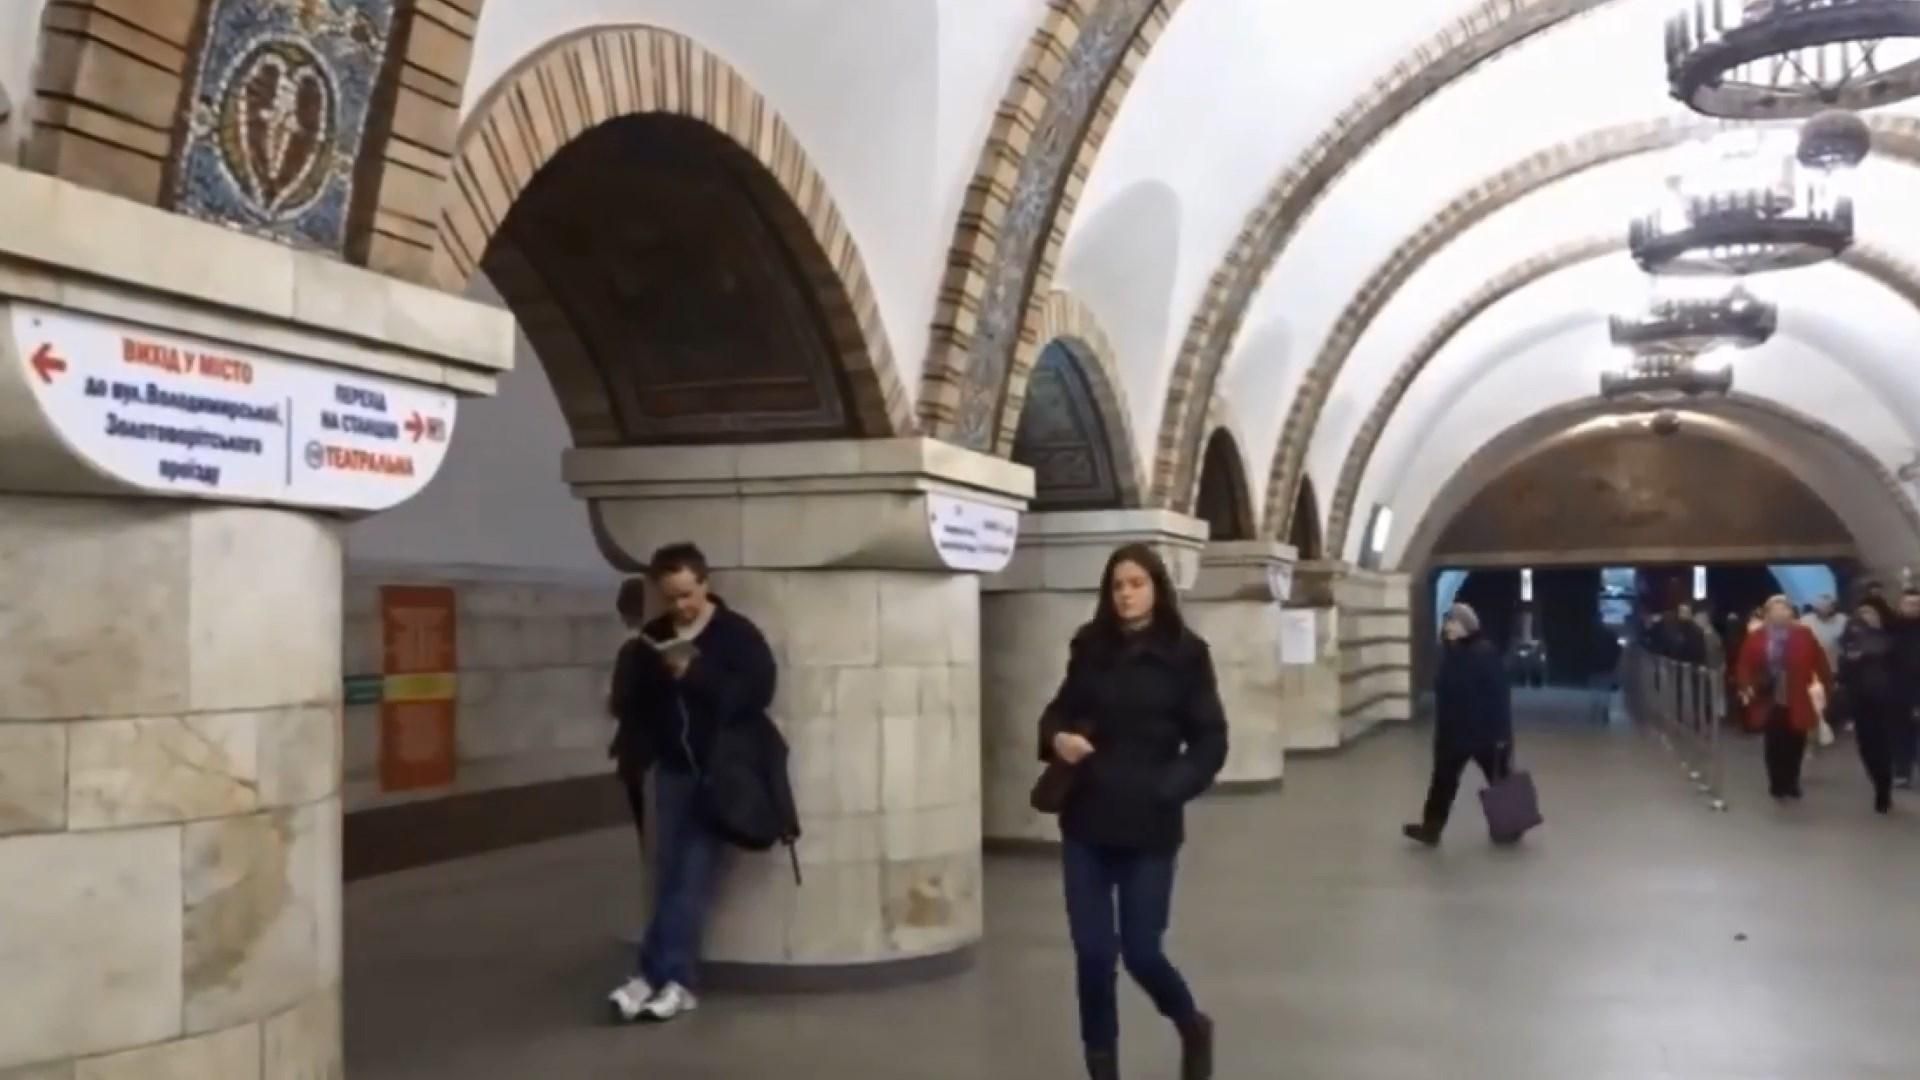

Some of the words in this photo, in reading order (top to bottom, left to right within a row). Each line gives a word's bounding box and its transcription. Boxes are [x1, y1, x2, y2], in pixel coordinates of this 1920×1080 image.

[123, 338, 180, 373] ВИХІД
[184, 352, 195, 372] У
[199, 353, 253, 384] МІСТО
[321, 410, 338, 429] НА
[326, 445, 414, 477] ТЕАТРАЛЬНА
